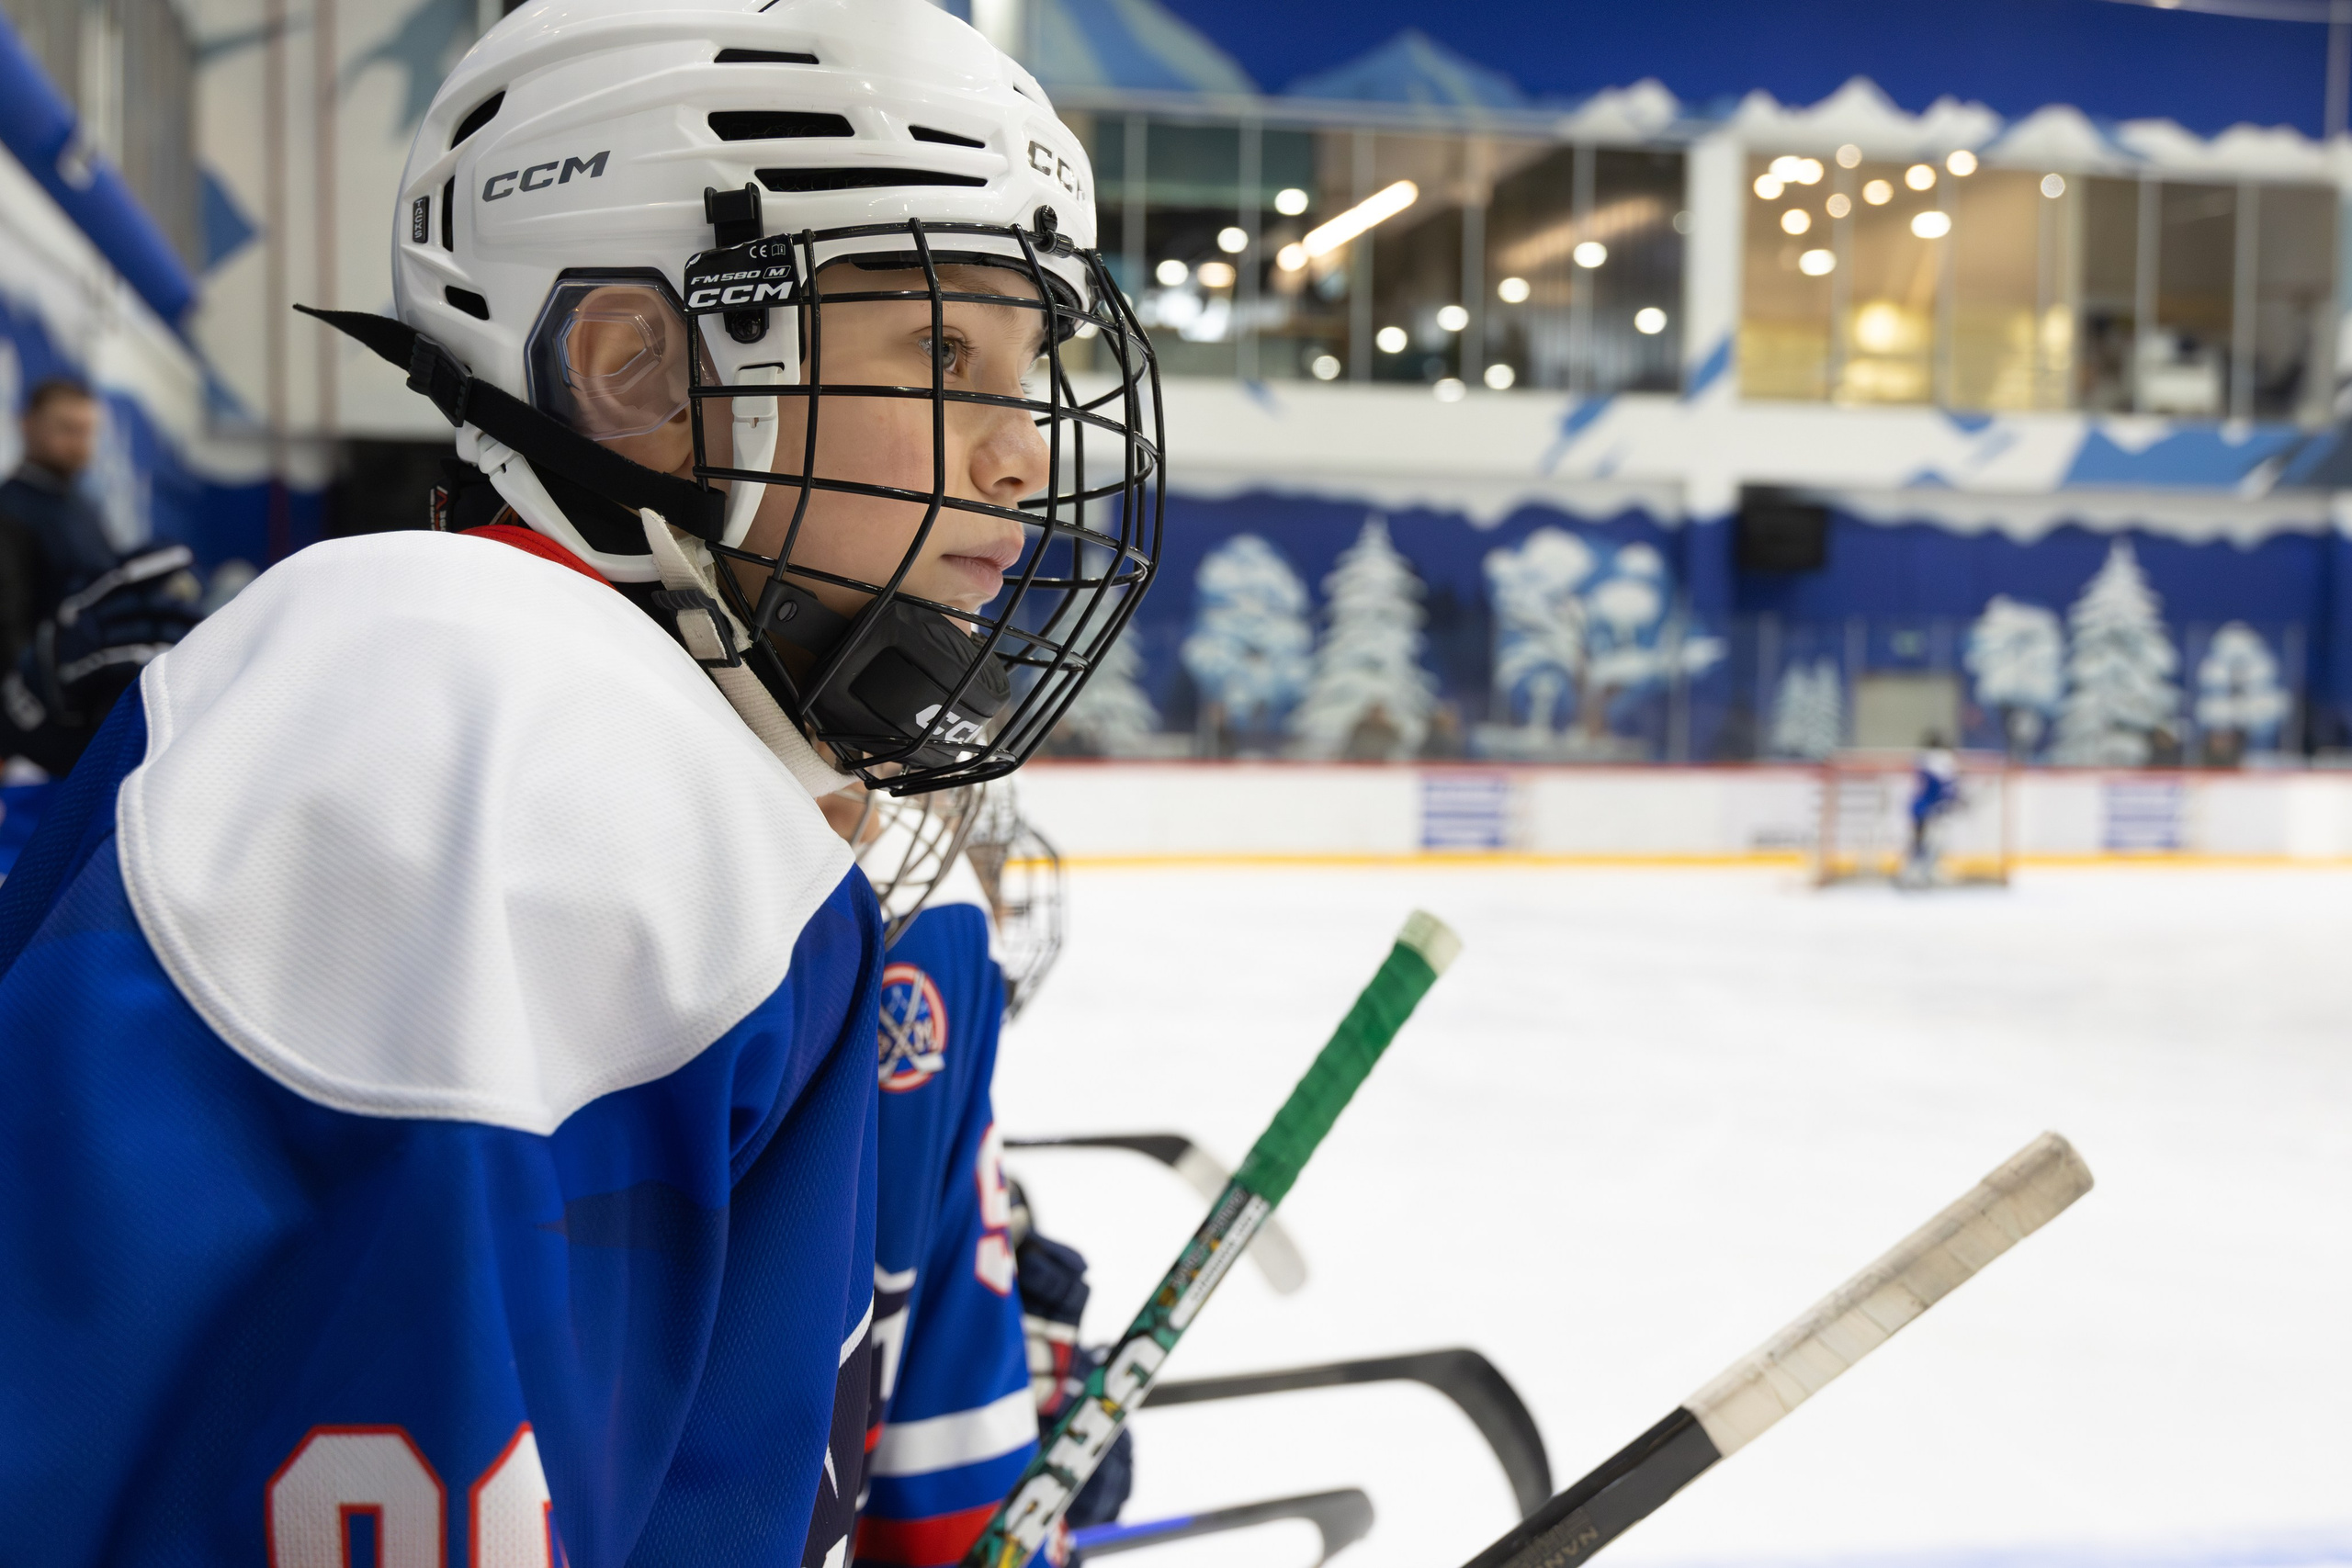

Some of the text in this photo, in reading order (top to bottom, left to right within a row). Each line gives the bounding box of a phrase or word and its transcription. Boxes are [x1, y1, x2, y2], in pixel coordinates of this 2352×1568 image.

[482, 151, 611, 202] CCM
[414, 199, 424, 239] TACKS
[688, 281, 793, 308] CCM
[916, 705, 983, 743] CC
